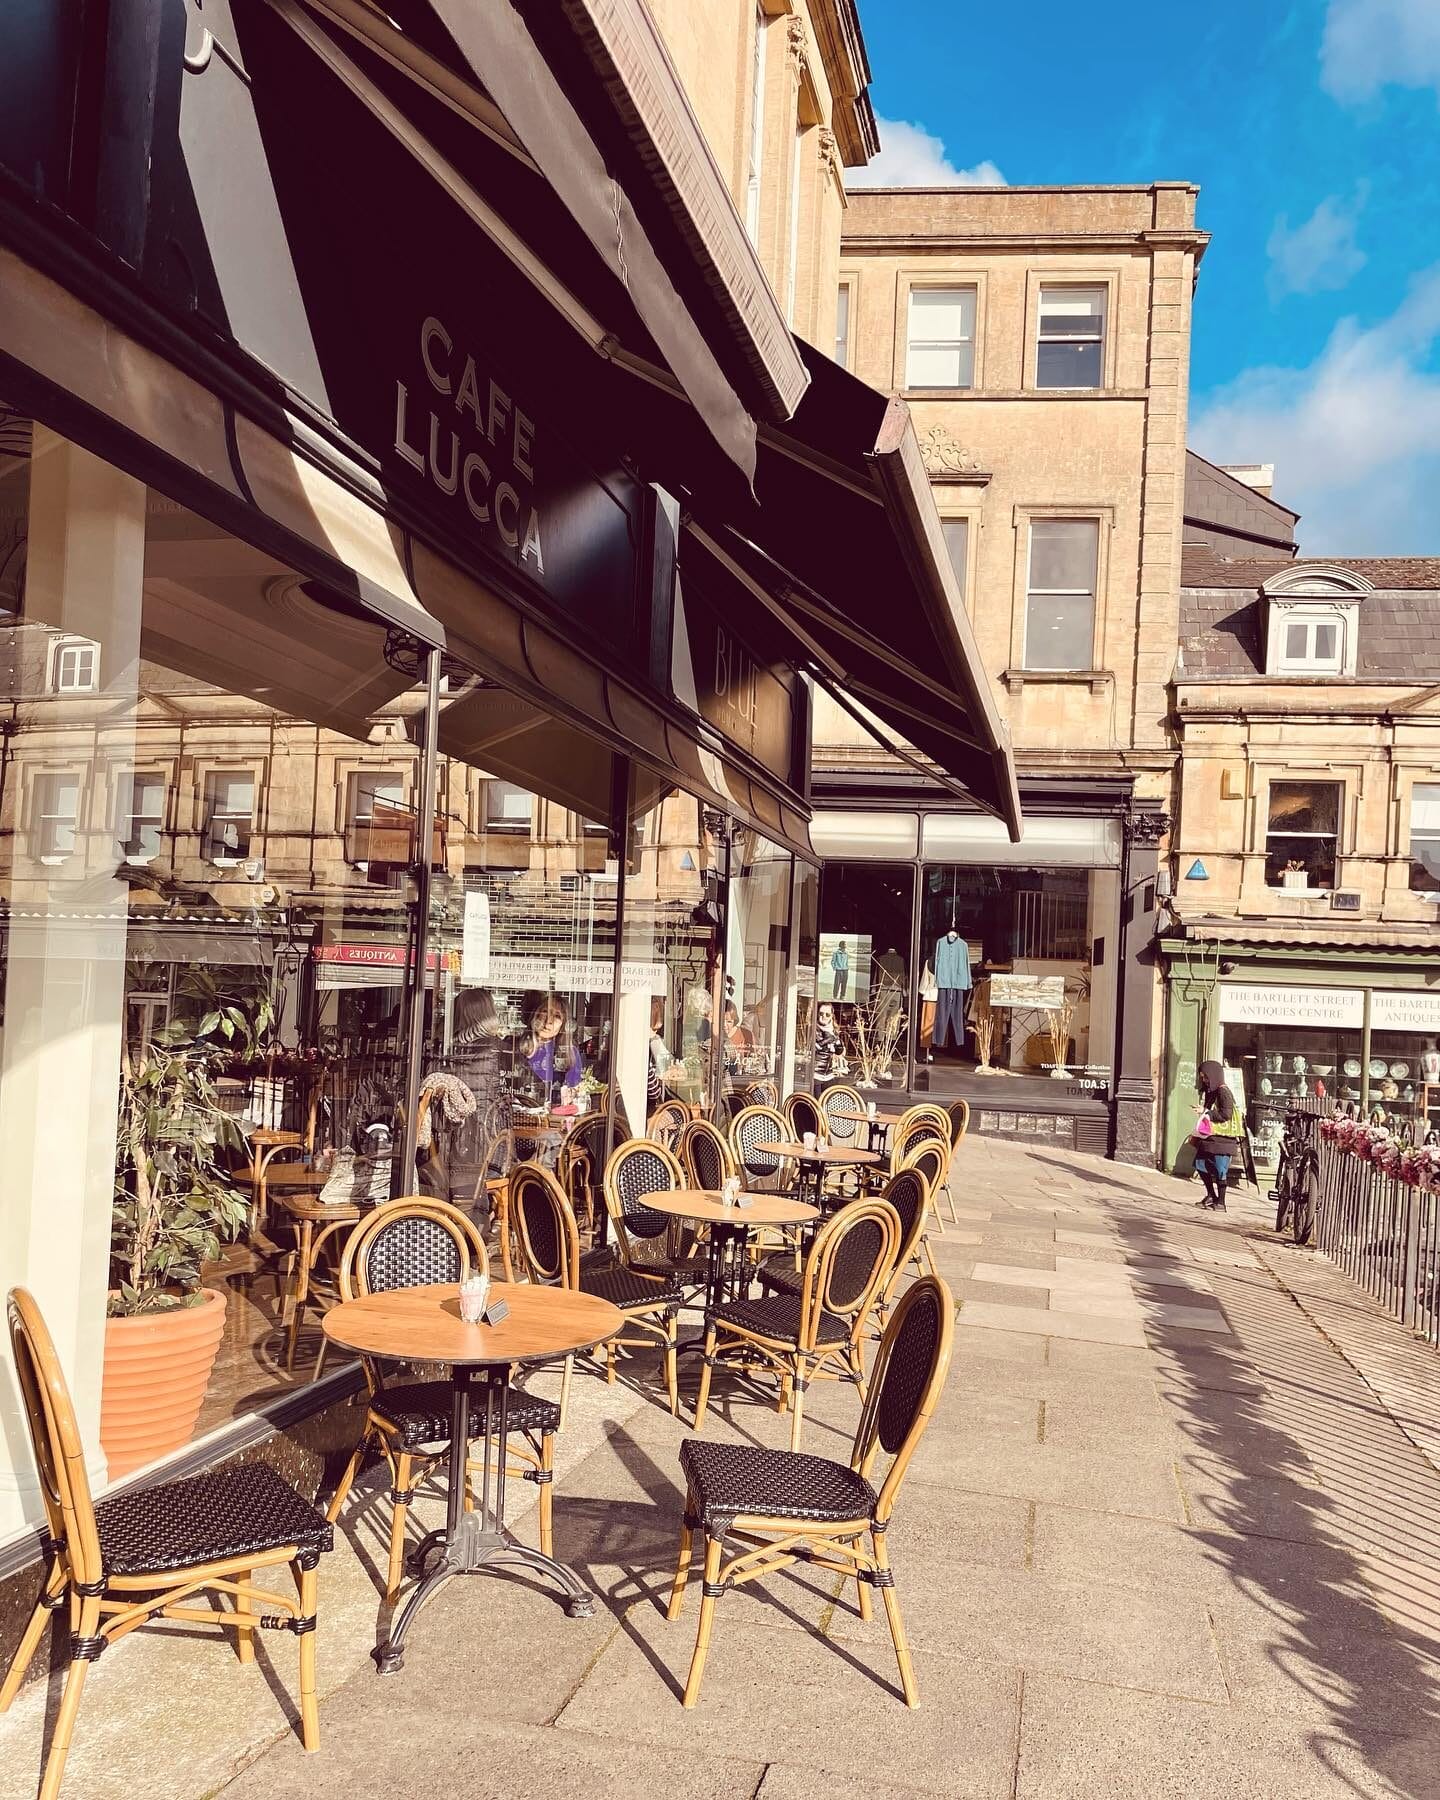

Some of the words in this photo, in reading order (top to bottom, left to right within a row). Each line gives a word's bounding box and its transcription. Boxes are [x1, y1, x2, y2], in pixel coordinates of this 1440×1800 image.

[421, 316, 536, 485] CAFE
[394, 380, 545, 575] LUCCA
[1229, 991, 1250, 1001] THE
[1253, 992, 1311, 1004] BARTLETT
[1313, 995, 1355, 1006] STREET
[1373, 998, 1396, 1008] THE
[1239, 1005, 1296, 1017] ANTIQUES
[1298, 1008, 1344, 1019] CENTRE
